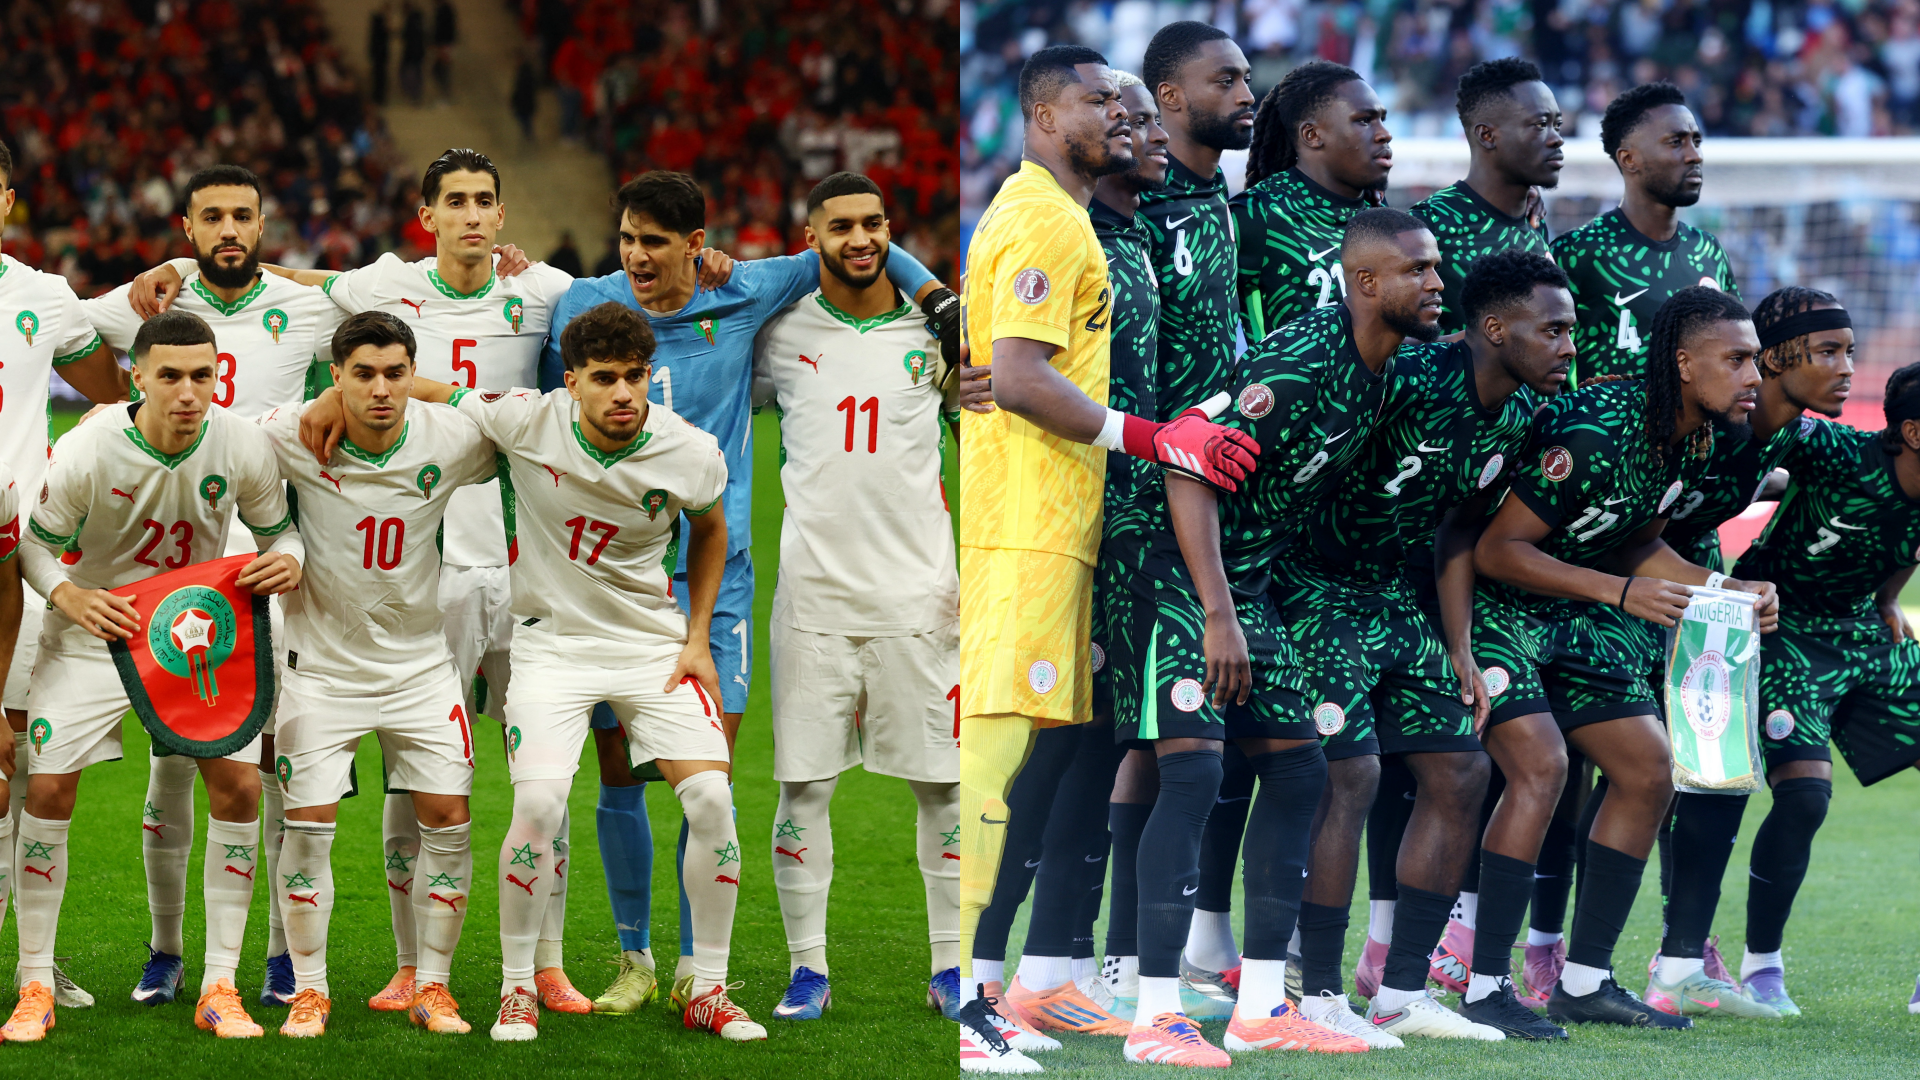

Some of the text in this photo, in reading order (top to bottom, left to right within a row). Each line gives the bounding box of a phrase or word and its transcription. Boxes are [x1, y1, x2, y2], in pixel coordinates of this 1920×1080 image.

[1173, 228, 1194, 277] 6
[934, 295, 958, 314] BONO
[1307, 263, 1348, 310] 21
[1085, 287, 1111, 333] 2
[1617, 308, 1642, 354] 4
[211, 352, 237, 409] 3
[451, 338, 477, 390] 5
[651, 365, 674, 411] 1
[836, 395, 879, 454] 11
[1292, 450, 1329, 483] 8
[1383, 455, 1422, 497] 2
[134, 518, 194, 569] 23
[356, 515, 405, 571] 10
[564, 515, 619, 566] 17
[1565, 506, 1620, 542] 17
[1807, 526, 1842, 556] 7
[213, 612, 220, 621] DE
[213, 620, 223, 650] FOOTBALL
[1694, 598, 1743, 627] NIGERIA
[731, 618, 747, 674] 1
[1681, 675, 1692, 718] NIGERIA
[1690, 653, 1722, 674] FOOTBALL
[1699, 728, 1715, 738] 1945
